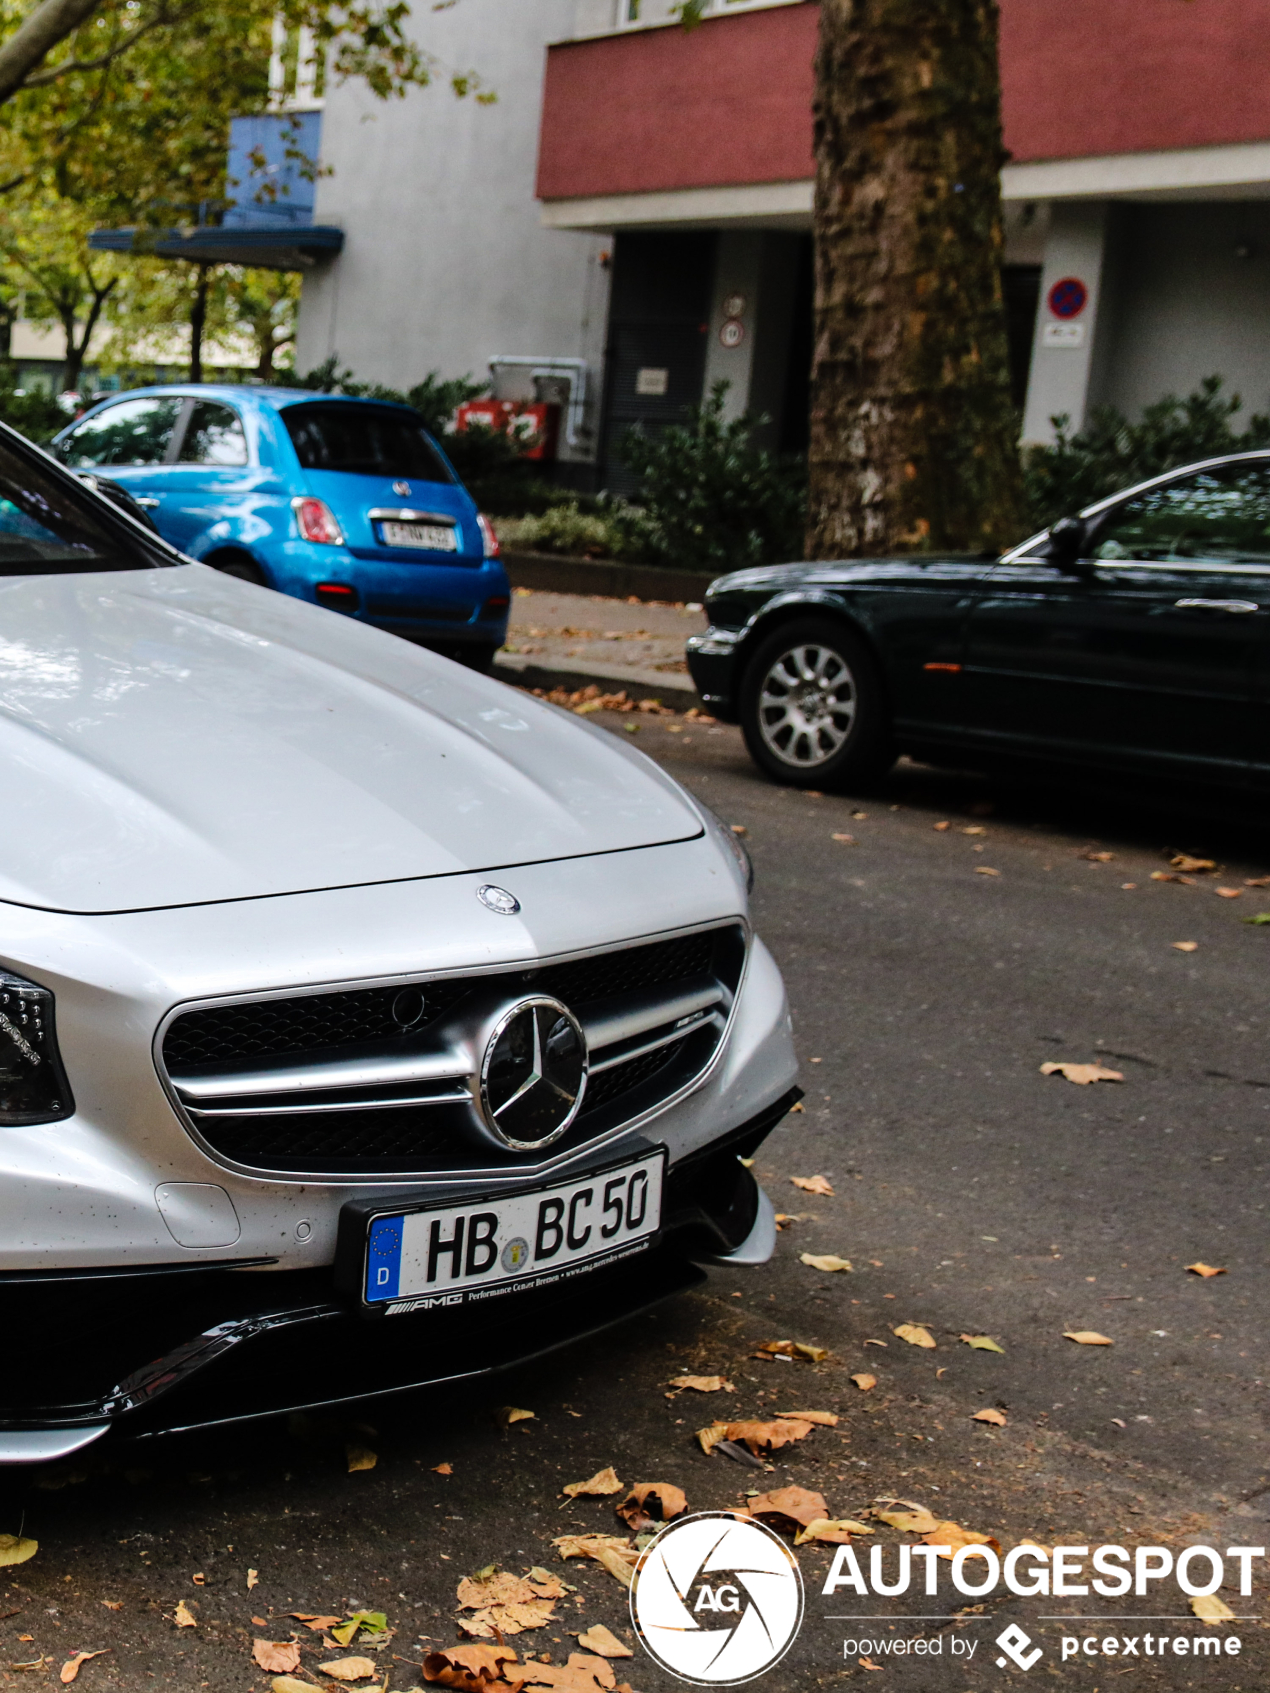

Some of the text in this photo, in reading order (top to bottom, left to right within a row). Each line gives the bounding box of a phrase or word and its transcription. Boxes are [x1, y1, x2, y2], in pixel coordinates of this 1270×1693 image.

[427, 1212, 498, 1282] HB
[534, 1188, 593, 1261] BC
[601, 1169, 648, 1239] 50
[377, 1267, 390, 1285] D
[468, 1286, 512, 1301] Performance
[536, 1274, 559, 1287] Bremen
